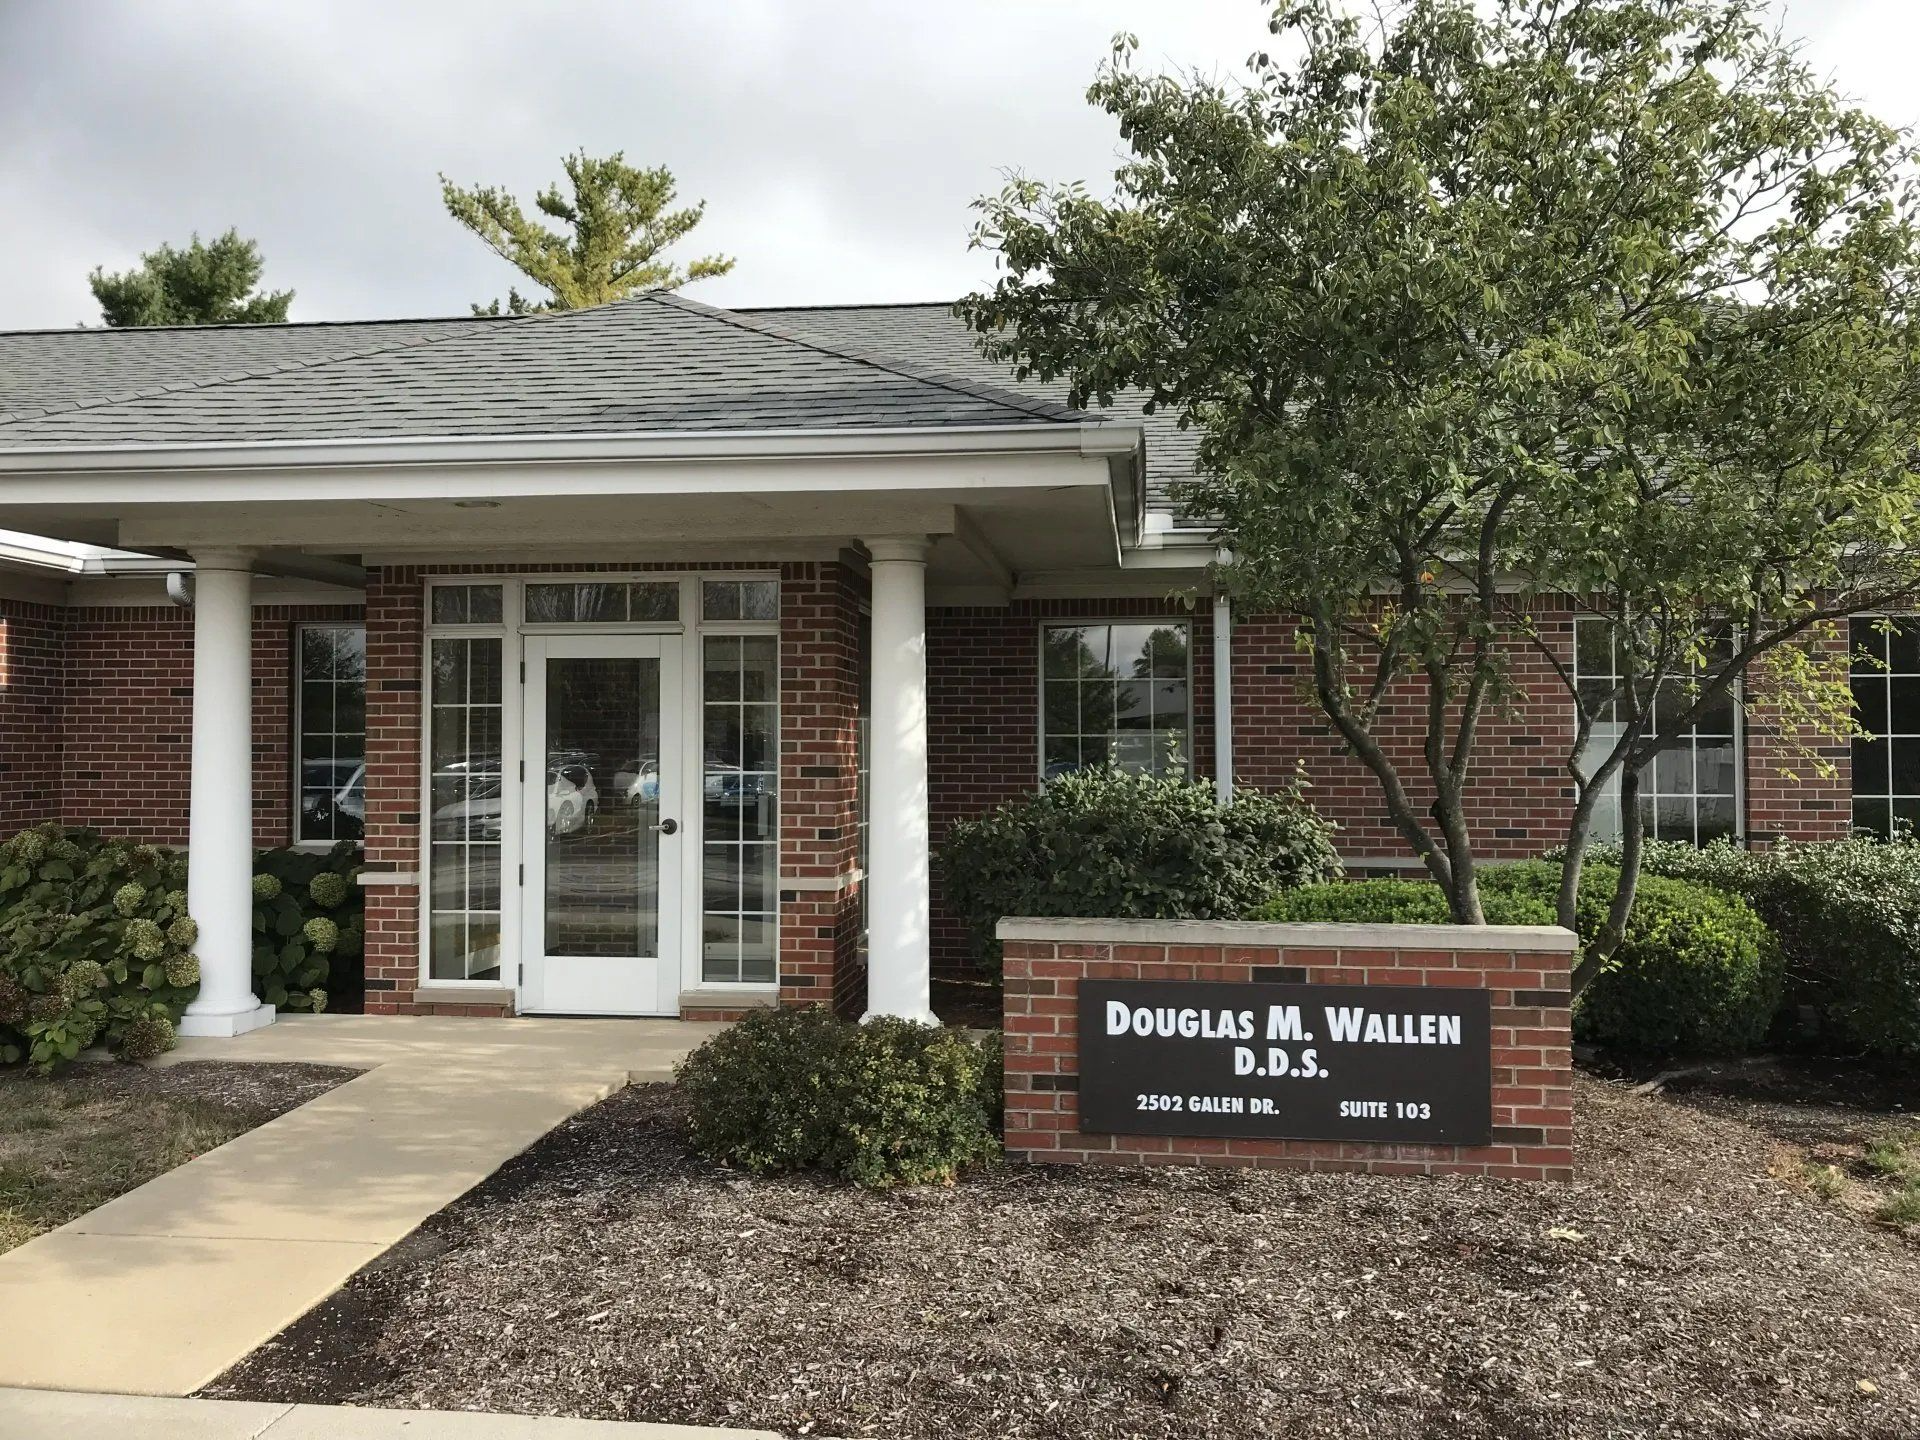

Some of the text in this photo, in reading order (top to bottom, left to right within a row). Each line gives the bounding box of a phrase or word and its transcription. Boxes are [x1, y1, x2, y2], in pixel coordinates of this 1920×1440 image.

[1106, 1000, 1461, 1045] DOUGLAS M. WALLEN
[1234, 1046, 1329, 1079] D.D.S.
[1136, 1094, 1280, 1115] 2502 GALEN DR.
[1340, 1100, 1431, 1120] SUITE 103
